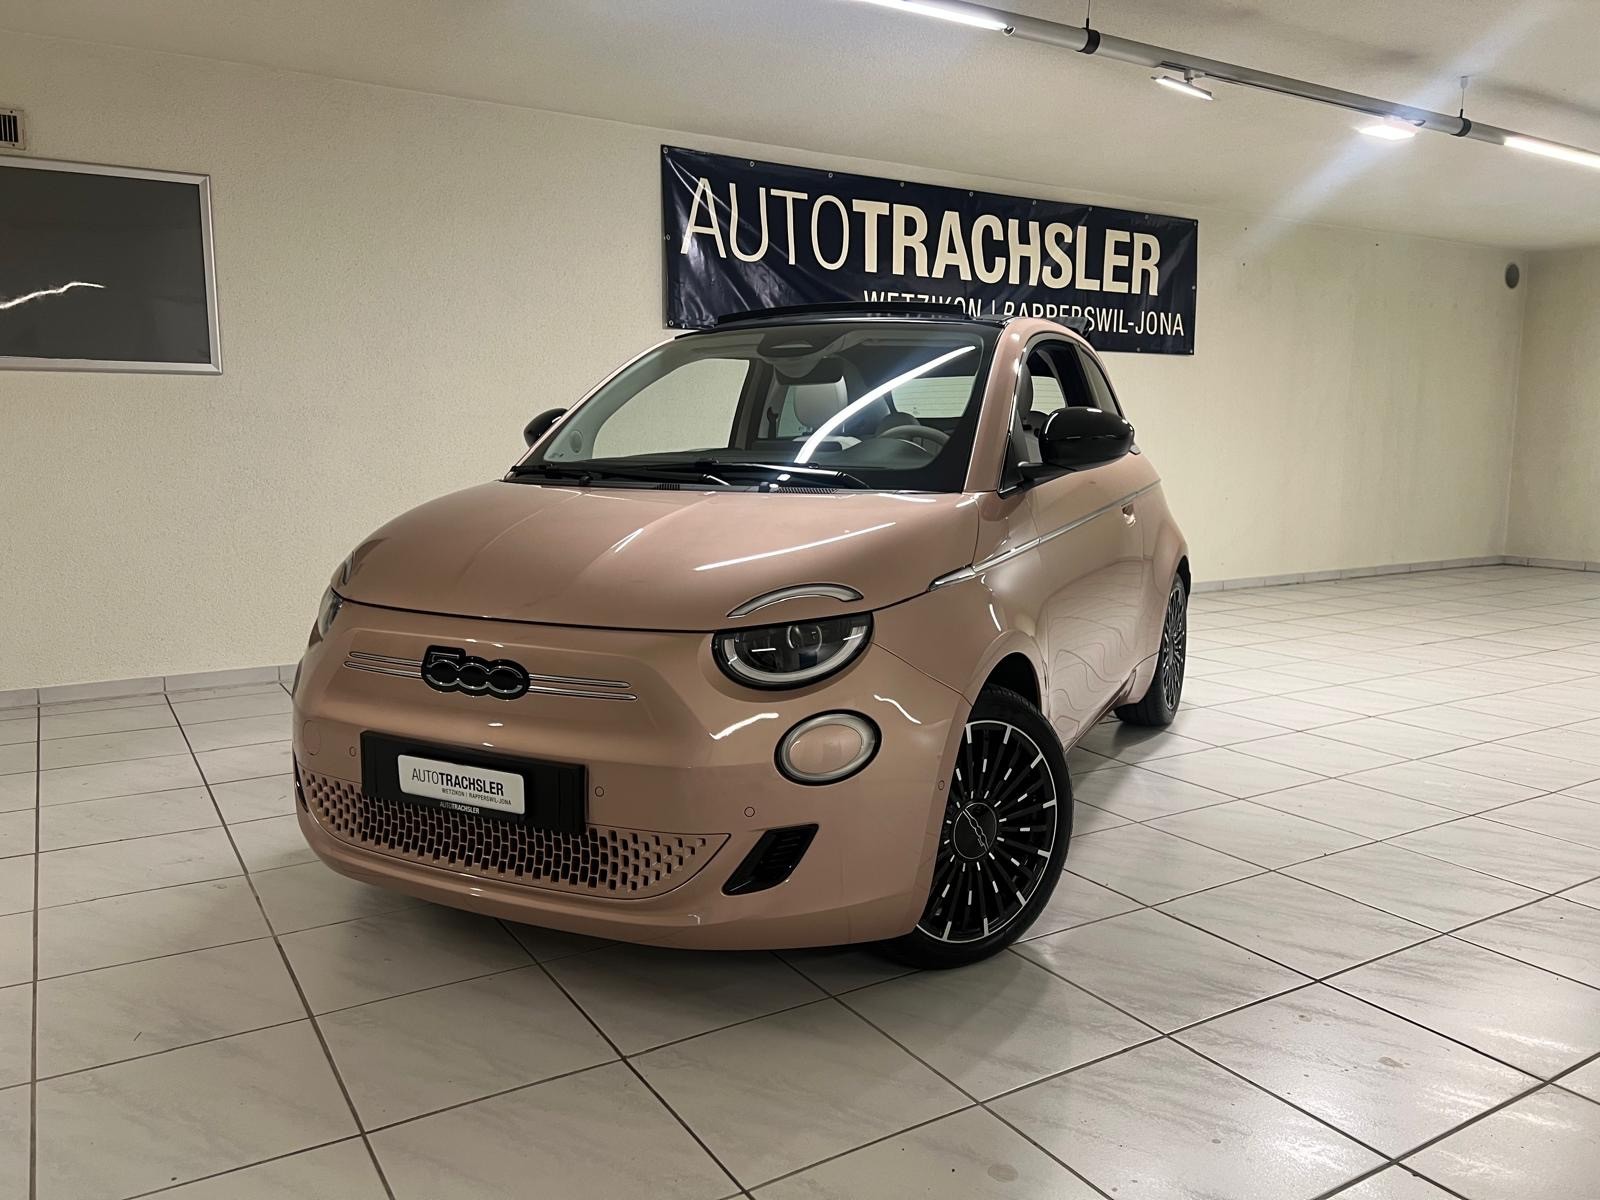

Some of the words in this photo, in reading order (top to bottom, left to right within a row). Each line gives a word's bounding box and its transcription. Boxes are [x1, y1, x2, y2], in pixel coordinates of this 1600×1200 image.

[680, 176, 1162, 297] AUTOTRACHSLER
[421, 645, 530, 701] 500
[411, 767, 505, 797] AUTOTRACHSLER
[441, 787, 465, 797] WETZIKON
[468, 792, 512, 805] RAPPERSWIL-JONA
[439, 800, 480, 814] AUTOTRACHSLER
